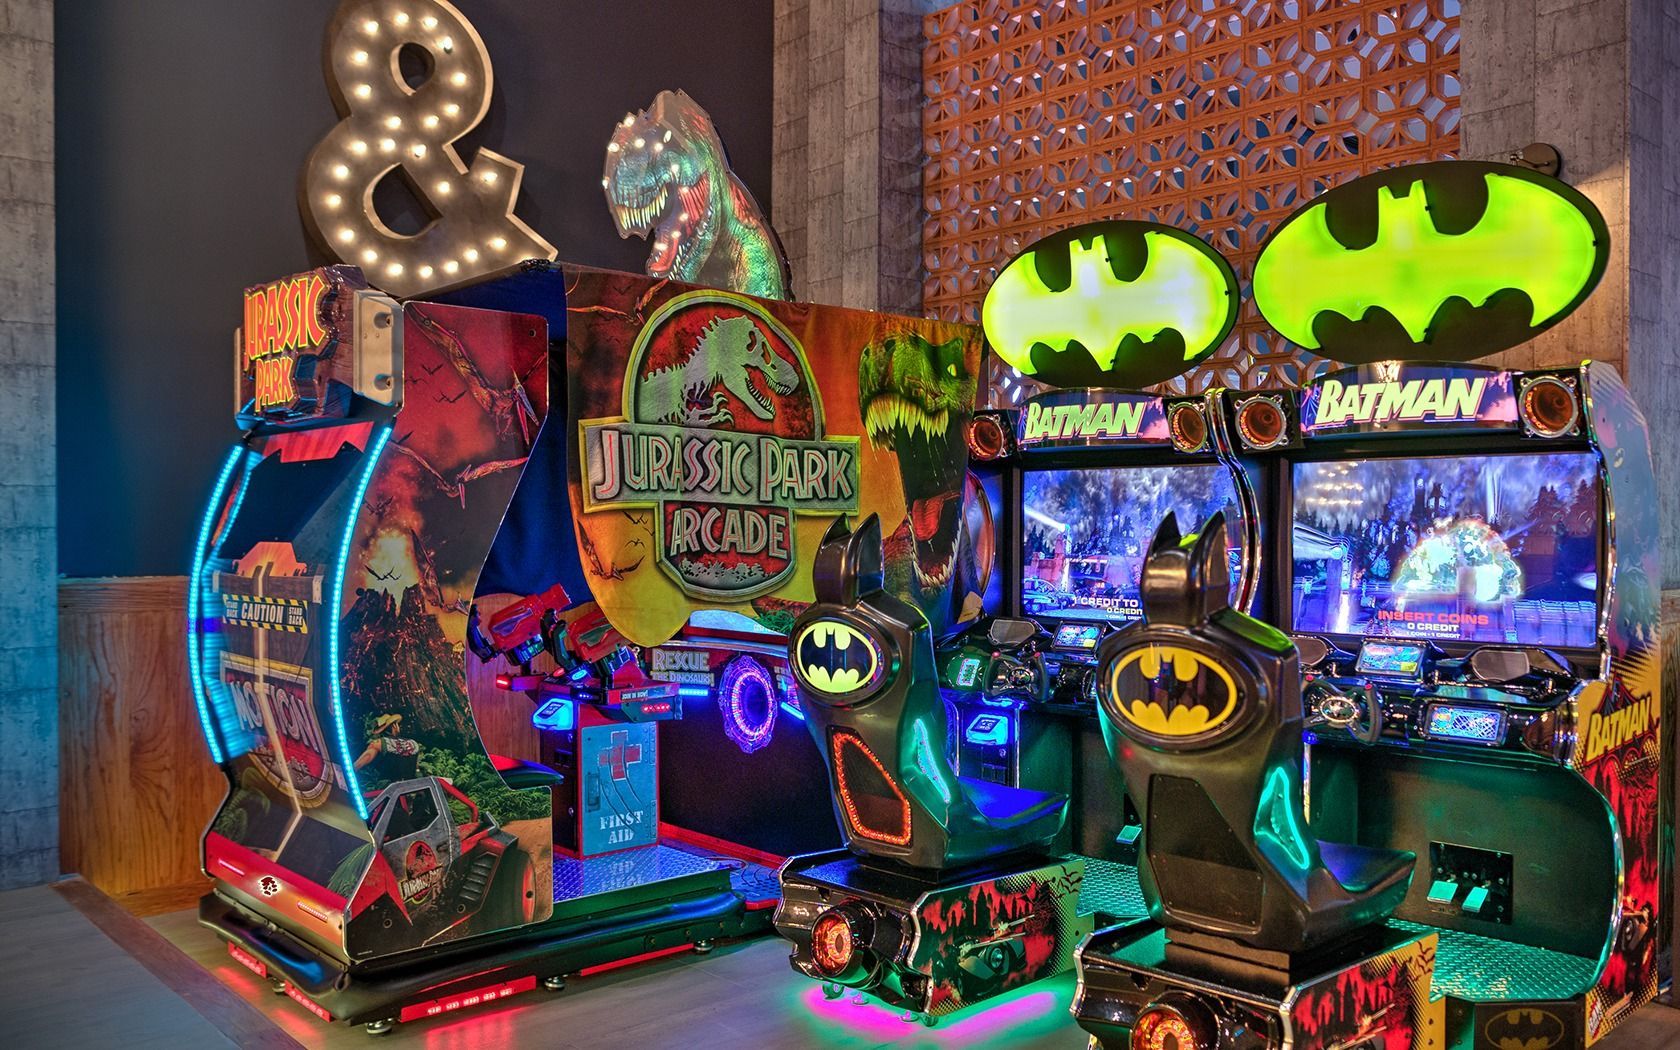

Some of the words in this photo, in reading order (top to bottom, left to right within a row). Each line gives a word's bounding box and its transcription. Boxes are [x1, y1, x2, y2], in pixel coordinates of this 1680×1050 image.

[297, 0, 558, 299] &
[244, 276, 325, 370] JURASSIC
[255, 357, 293, 412] PARK
[1315, 377, 1488, 425] BATMAN
[1024, 402, 1147, 440] BATMAN
[594, 429, 752, 500] JURASSIC
[759, 437, 853, 501] PARK
[669, 507, 788, 559] ARCADE
[241, 602, 284, 624] CAUTION
[288, 606, 303, 615] STAND
[1081, 596, 1121, 608] CREDIT
[1122, 599, 1139, 608] TO
[288, 615, 304, 625] BACK
[1378, 610, 1435, 622] INSERT
[1437, 613, 1489, 625] COINS
[1417, 622, 1460, 632] CREDIT
[652, 648, 710, 672] RESCUE
[650, 671, 669, 682] THE
[230, 681, 320, 755] MOTION
[1586, 696, 1652, 762] BATMAN
[600, 810, 644, 830] FIRST
[608, 829, 635, 844] AID
